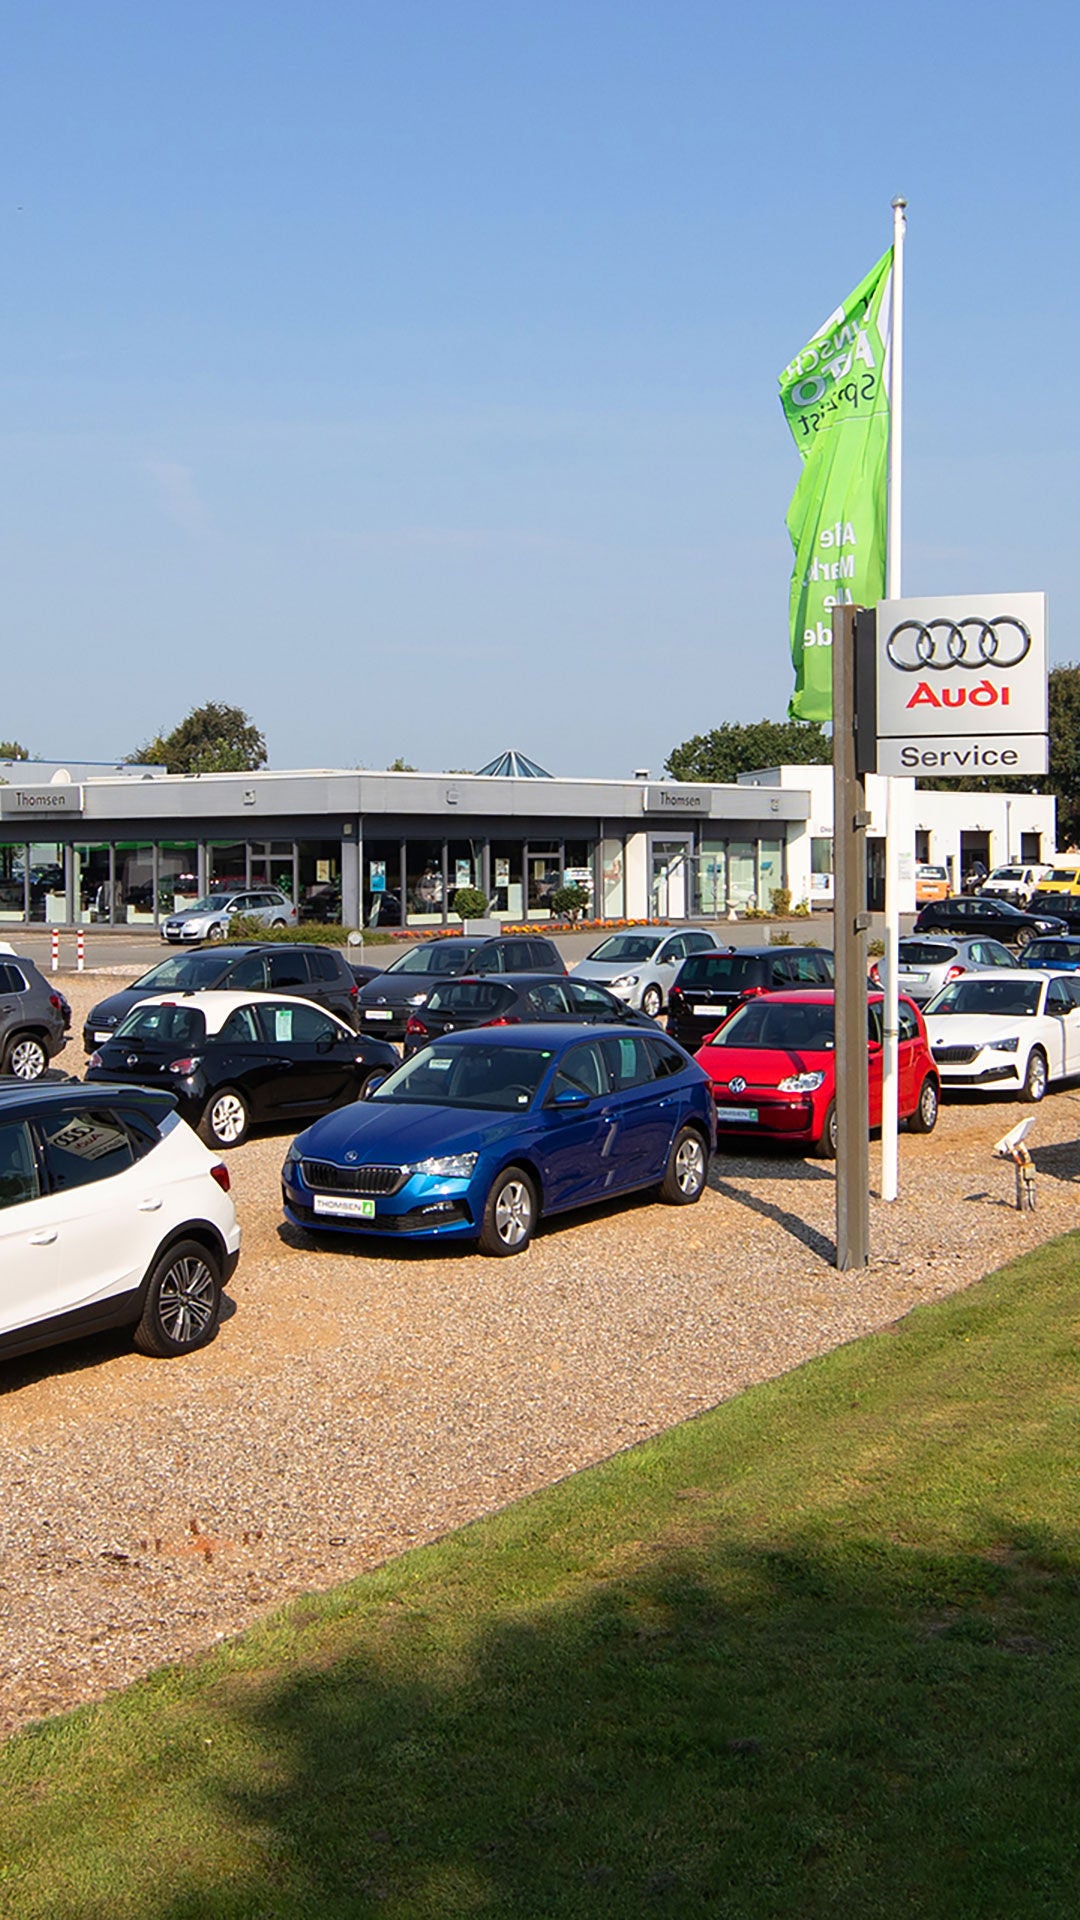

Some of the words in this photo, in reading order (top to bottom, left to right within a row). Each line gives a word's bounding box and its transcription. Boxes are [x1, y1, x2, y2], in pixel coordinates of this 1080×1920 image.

[905, 680, 1010, 709] Audi
[900, 744, 1019, 768] Service
[16, 792, 66, 806] Thomsen
[660, 791, 701, 806] Thomsen
[317, 1199, 362, 1211] THOMSEN
